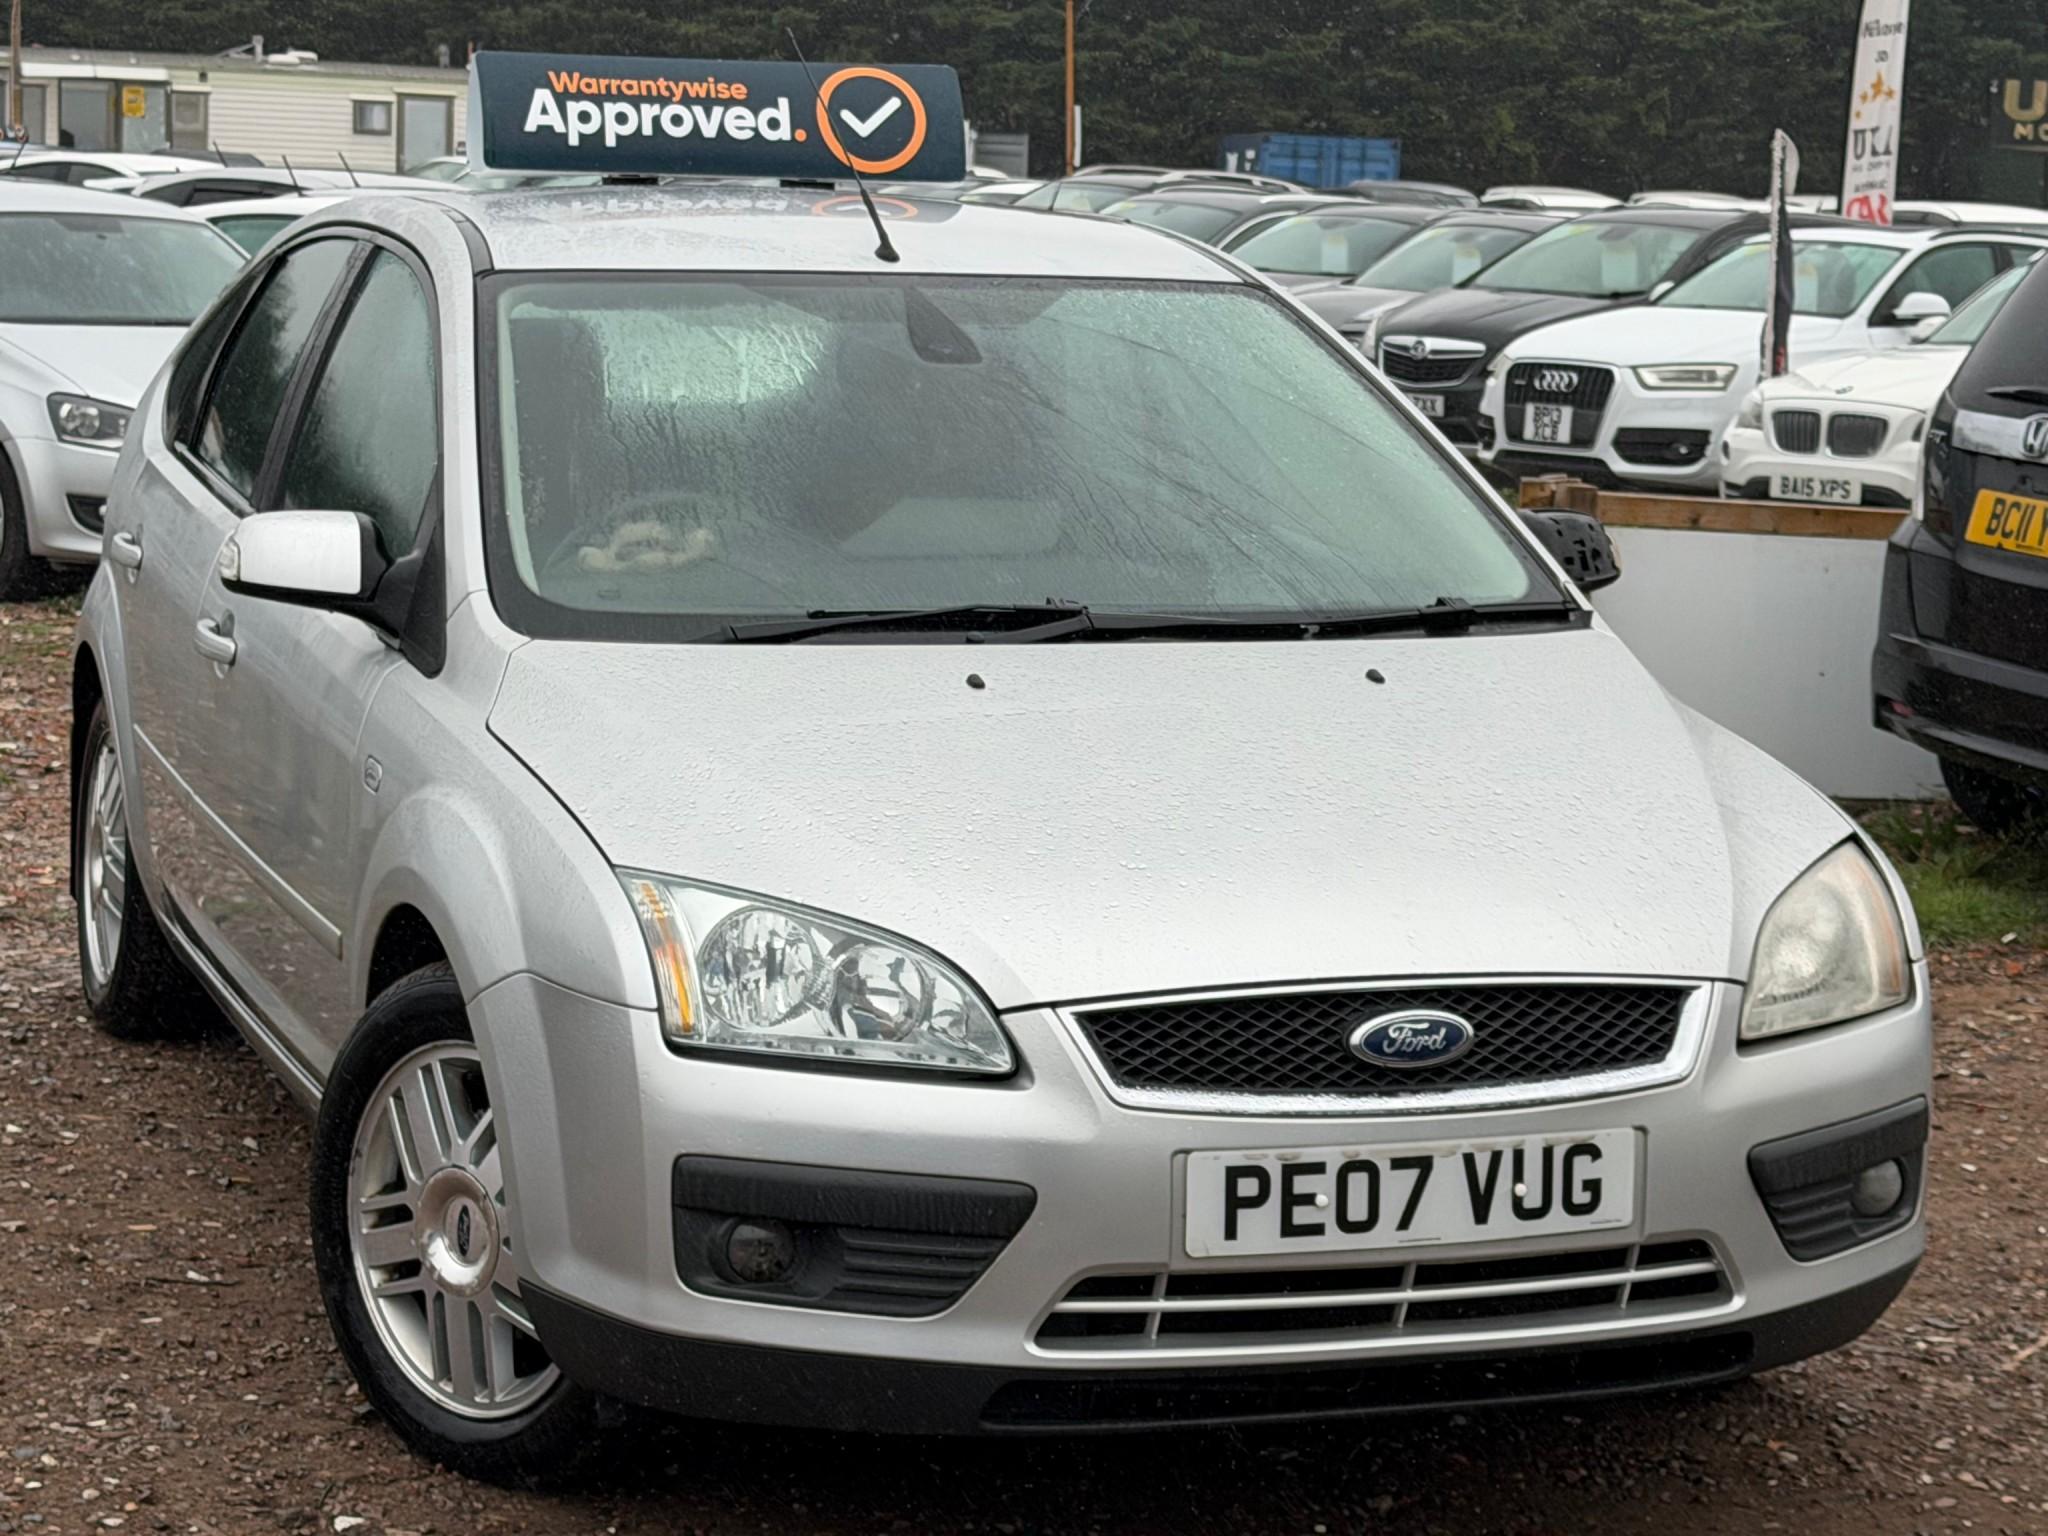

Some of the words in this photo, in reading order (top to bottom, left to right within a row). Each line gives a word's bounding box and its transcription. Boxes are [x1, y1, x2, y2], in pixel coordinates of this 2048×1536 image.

[548, 71, 747, 101] Warrantywise
[523, 88, 808, 147] Approved.
[1779, 476, 1814, 497] BA15
[1819, 478, 1851, 499] XPS
[1985, 497, 2037, 542] BC11
[1382, 1022, 1447, 1054] Ford
[1224, 1155, 1433, 1241] PE07
[1462, 1142, 1602, 1226] VUG
